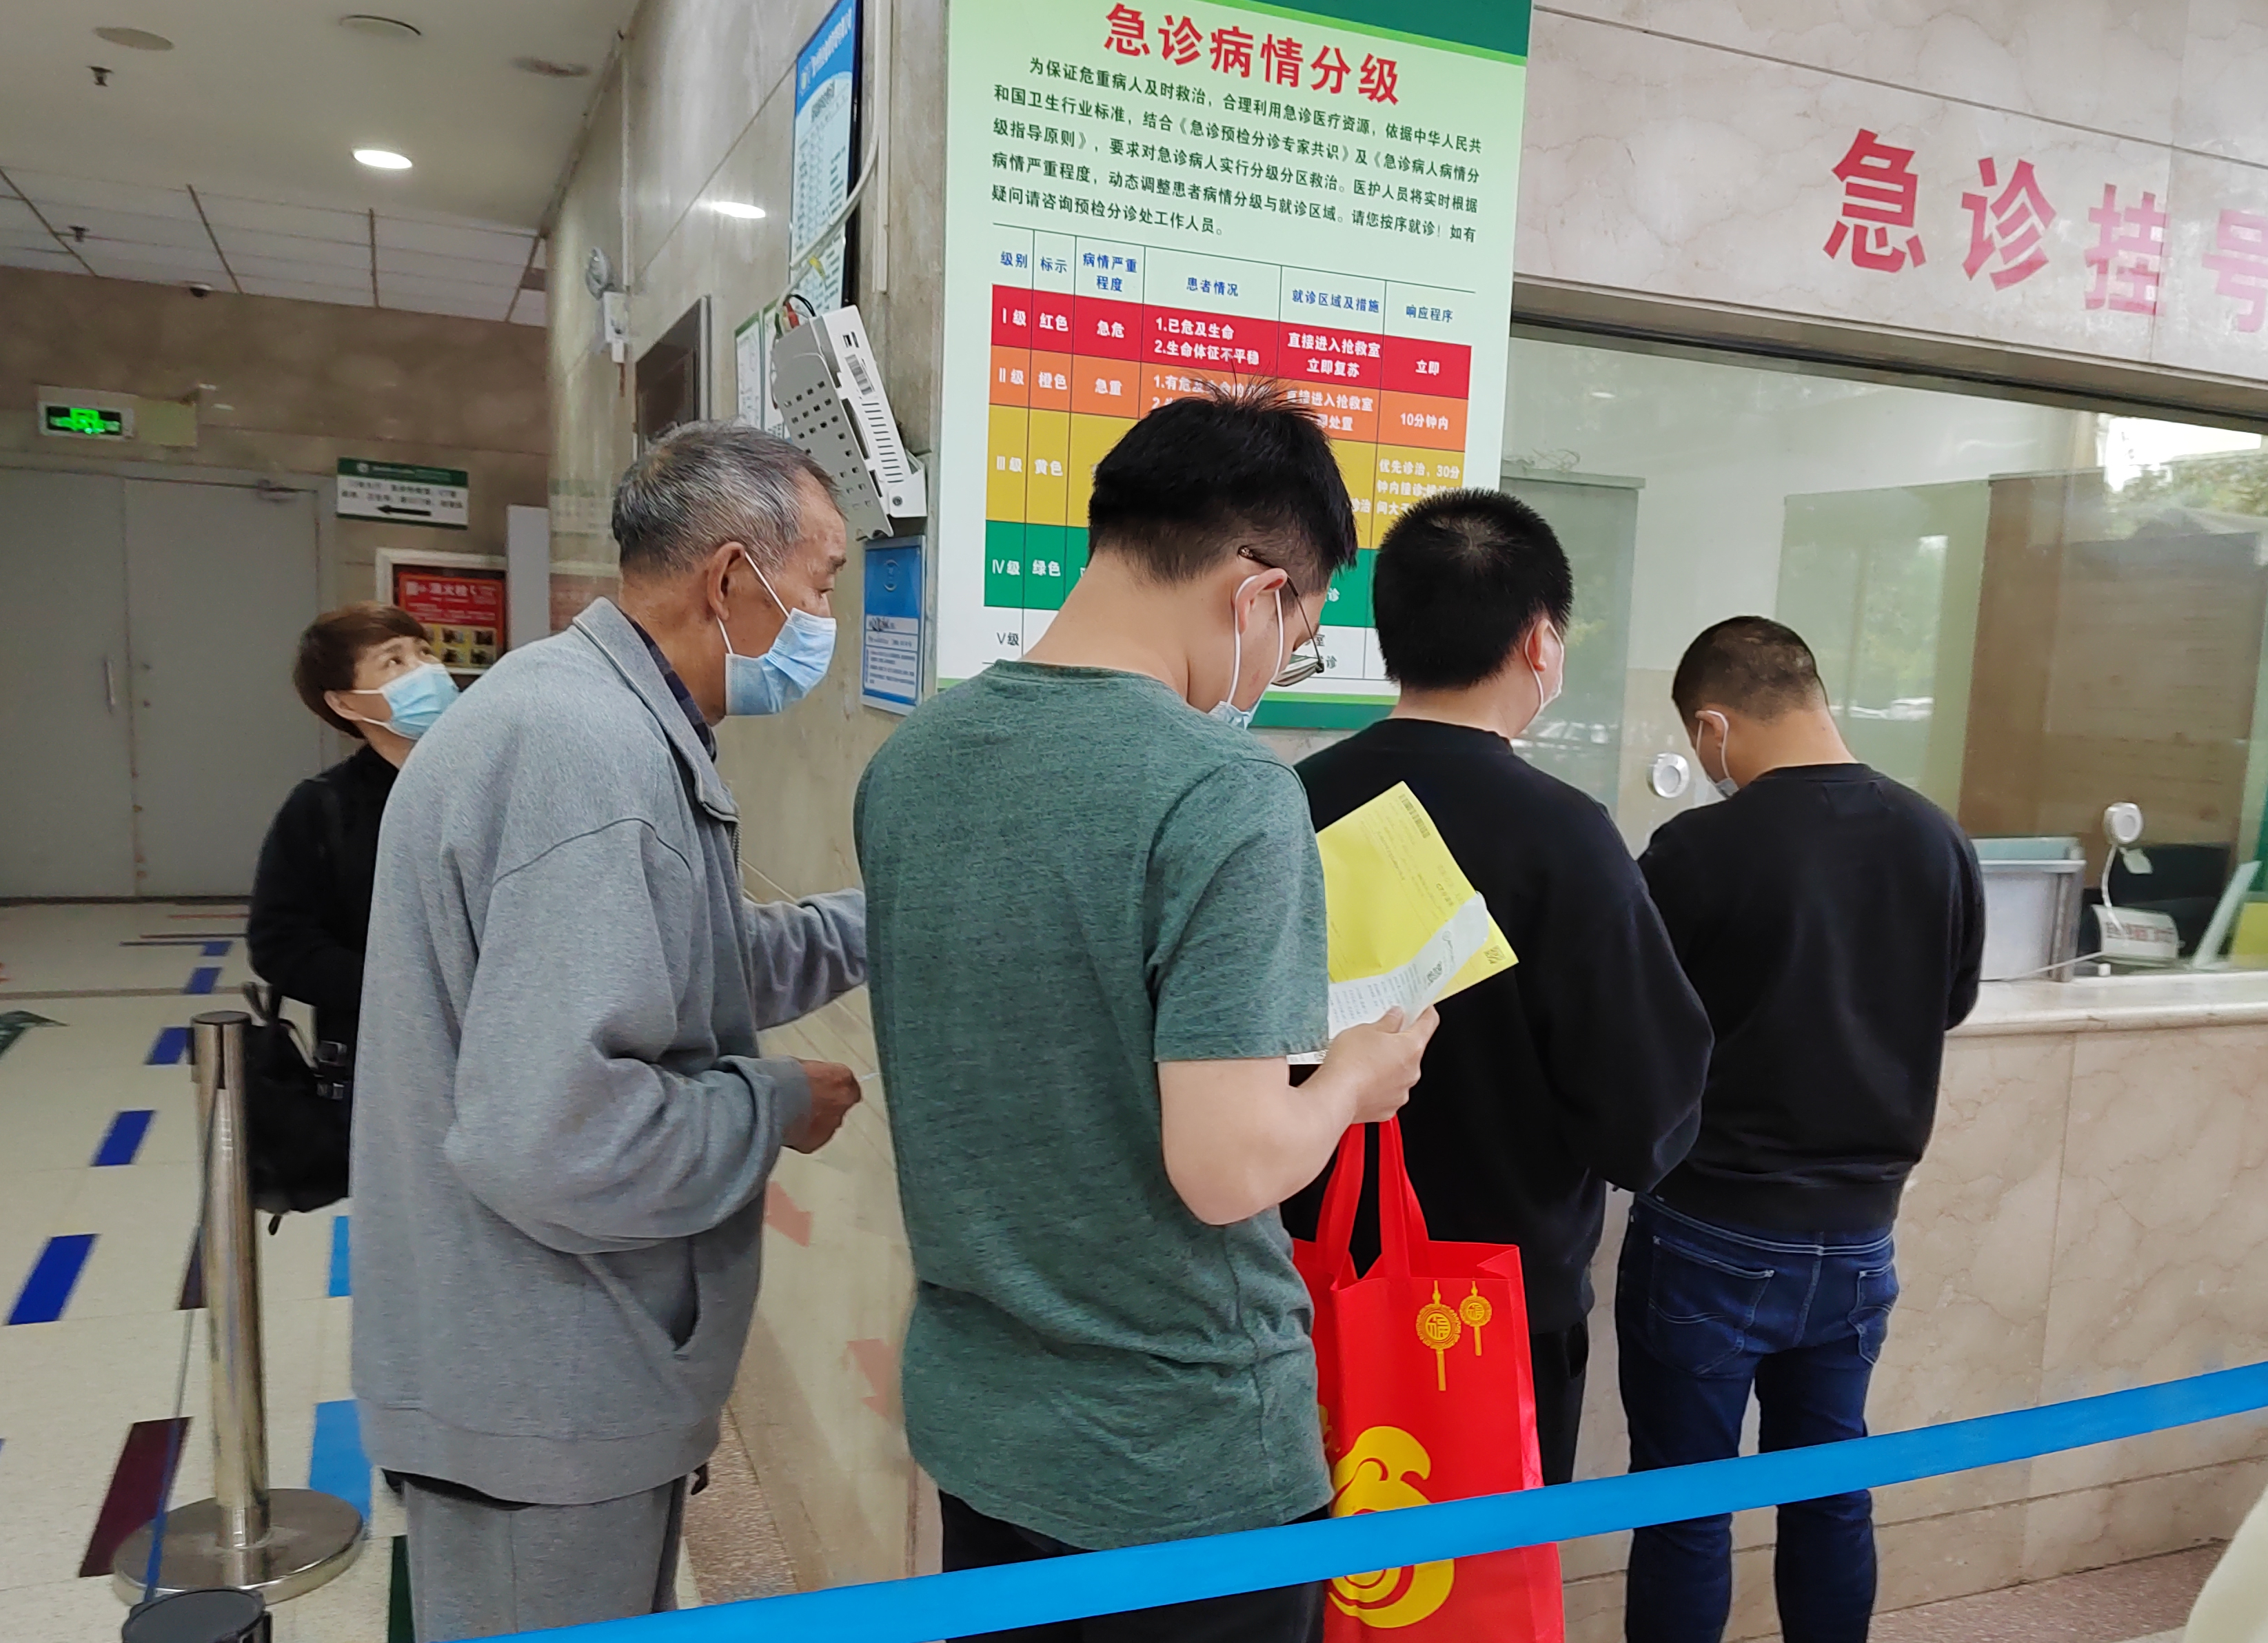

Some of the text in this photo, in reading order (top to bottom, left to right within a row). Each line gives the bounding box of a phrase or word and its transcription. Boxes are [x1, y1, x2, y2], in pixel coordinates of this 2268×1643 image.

[1103, 2, 1399, 105] 急诊病情分级
[991, 183, 1223, 236] 疑问请咨询预检分诊处工作人员。
[1823, 128, 2268, 333] 急诊挂号
[1000, 250, 1028, 269] 级别
[1040, 256, 1068, 274] 标示
[1082, 252, 1137, 274] 病情严重
[1096, 275, 1123, 292] 程度
[1186, 276, 1239, 296] 患者情况
[1292, 288, 1380, 314] 就诊区域及措施
[1039, 312, 1069, 332] 红色
[1405, 304, 1454, 323] 响应程序
[1096, 319, 1125, 338] 急危
[1155, 317, 1235, 340] 1.已危及生命
[1154, 339, 1259, 365] 2.生命体征不平稳
[1306, 359, 1361, 378] 立即复苏
[1415, 360, 1440, 376] 立即
[1038, 371, 1068, 391] 橙色
[1094, 378, 1123, 397] 急重
[1399, 412, 1449, 431] 10分钟内
[1034, 458, 1064, 477] 黄色
[1032, 559, 1062, 578] 绿色
